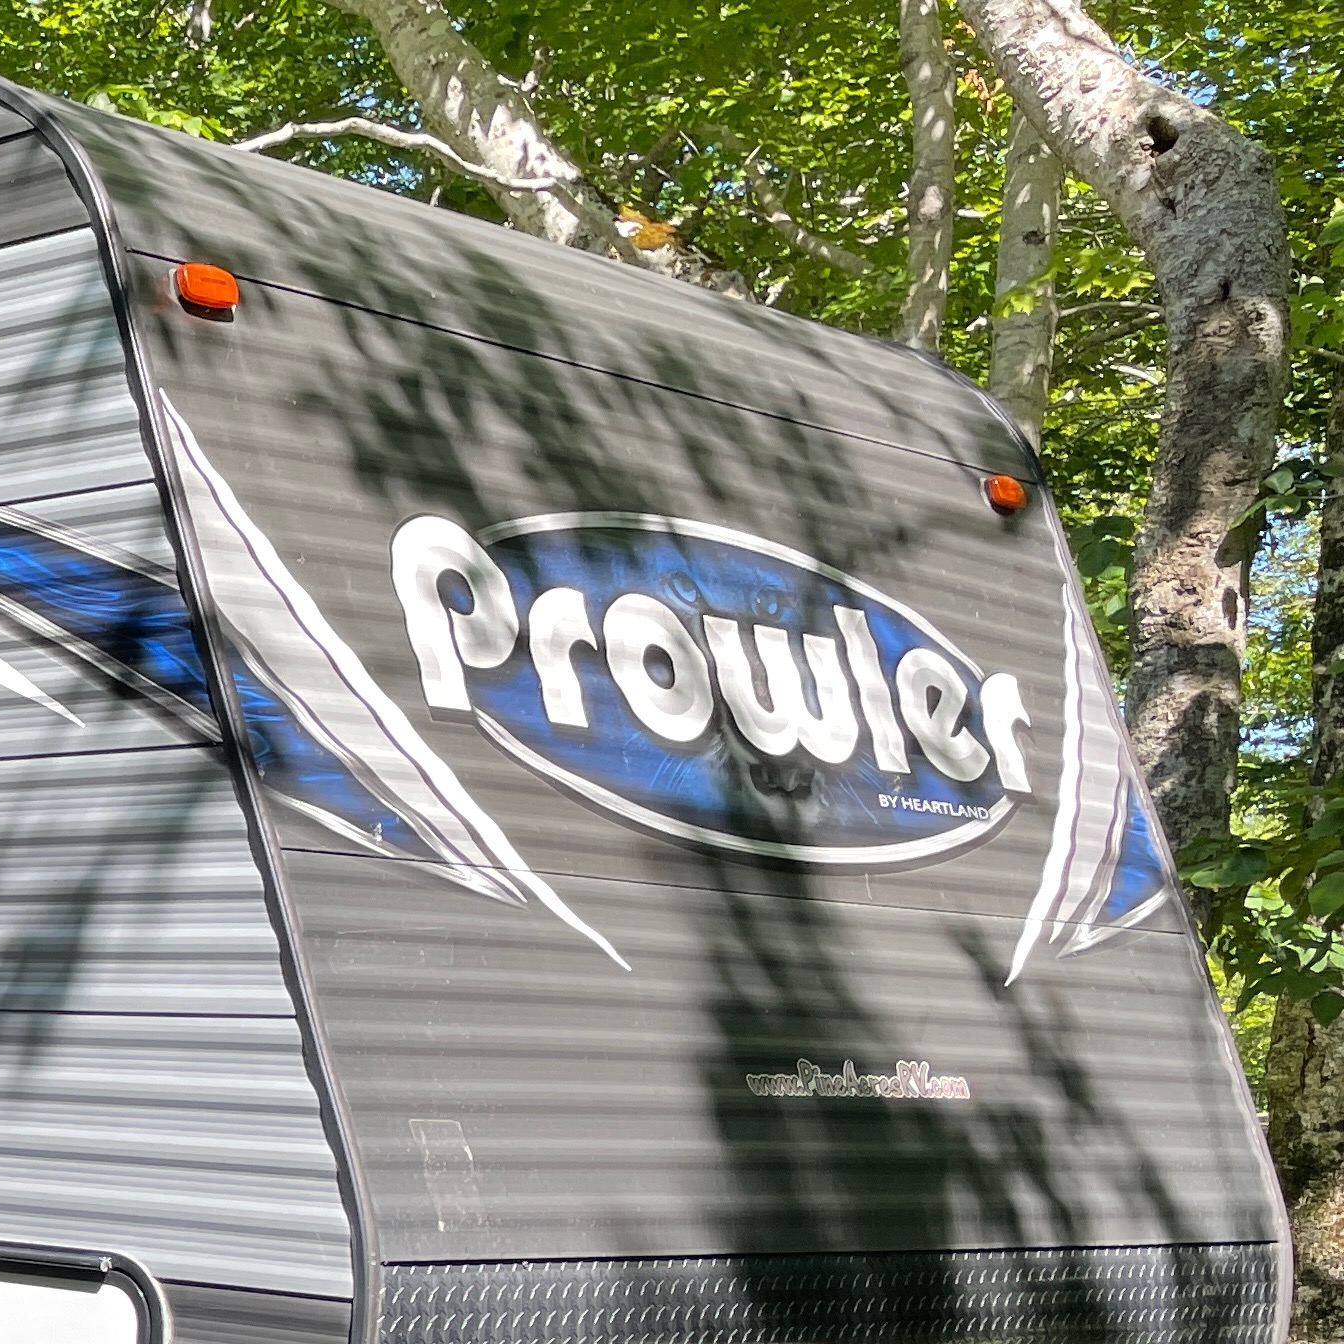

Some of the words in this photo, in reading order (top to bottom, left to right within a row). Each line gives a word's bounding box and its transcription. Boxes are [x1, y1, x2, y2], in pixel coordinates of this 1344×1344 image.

[390, 513, 1034, 795] Prowler
[878, 793, 898, 809] BY
[900, 796, 991, 820] HEARTLAND
[746, 1058, 971, 1100] www.PineAcresRV.com
